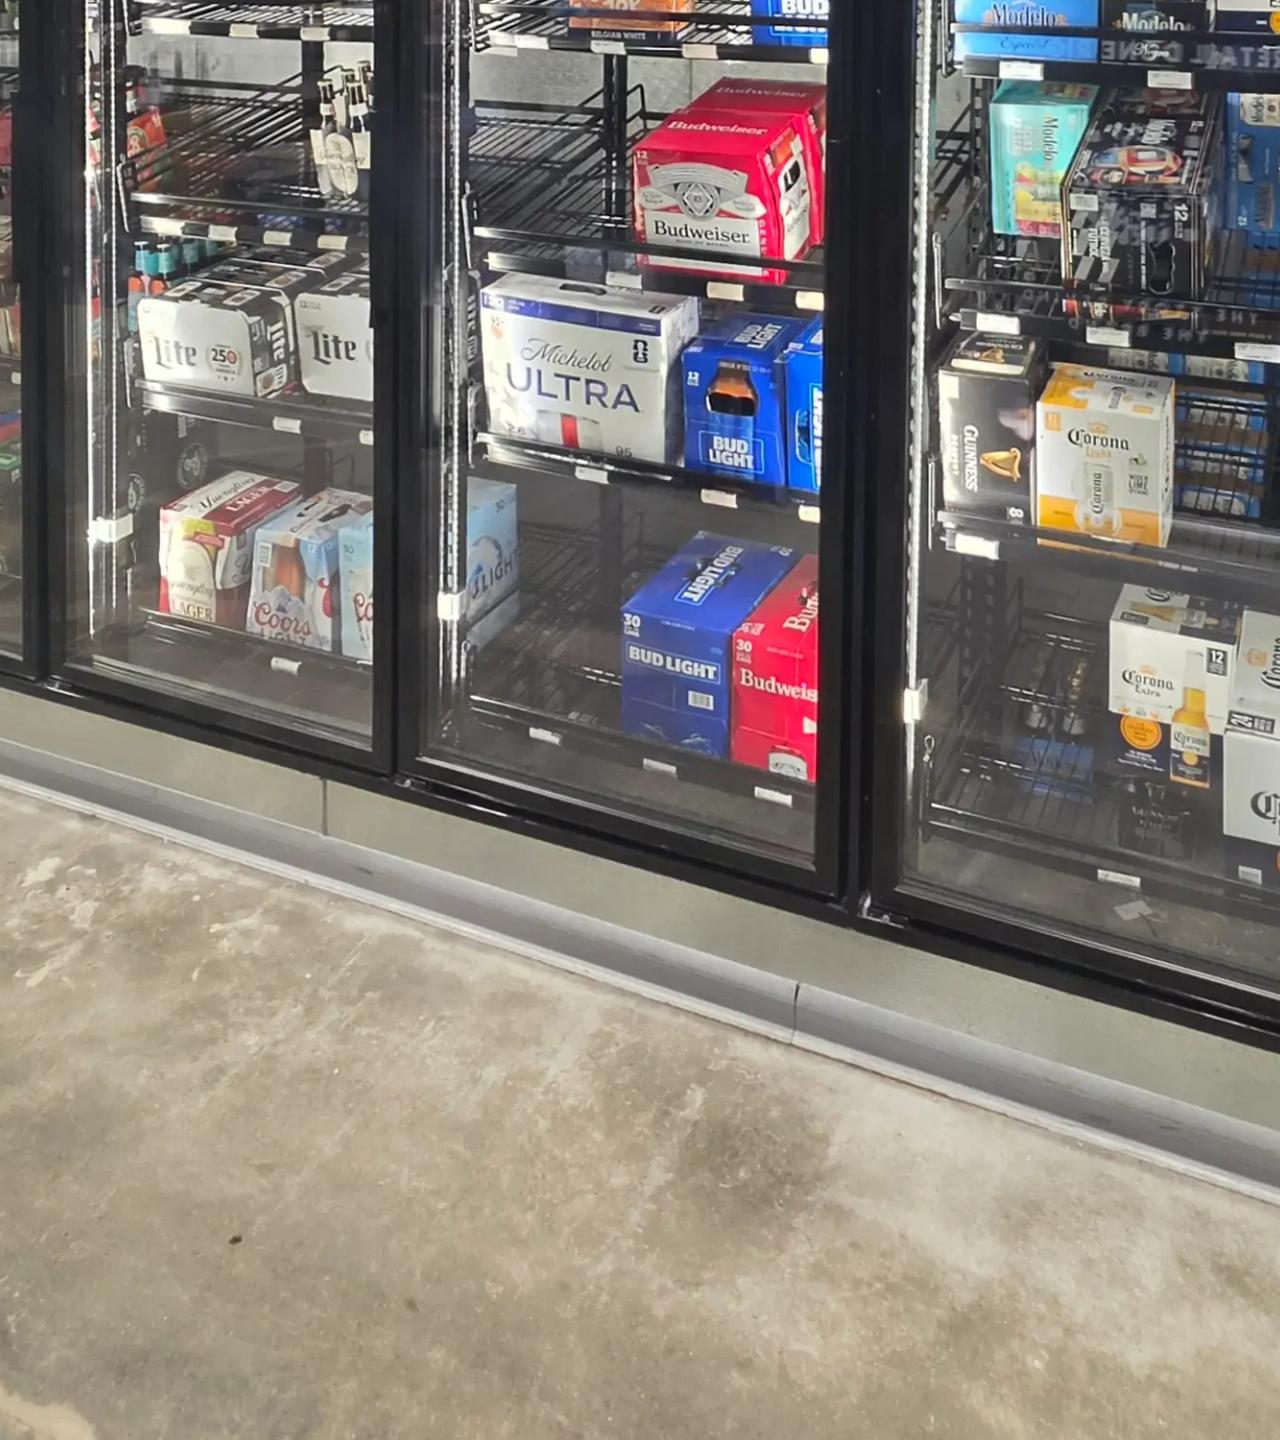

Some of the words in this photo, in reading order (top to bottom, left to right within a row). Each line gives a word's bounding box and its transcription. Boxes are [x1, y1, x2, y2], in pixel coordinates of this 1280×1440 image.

[991, 3, 1057, 27] Modelo
[623, 32, 646, 40] WHITE
[667, 120, 768, 136] Budweiser
[1042, 114, 1059, 162] Modelo
[635, 150, 648, 159] 12
[1173, 202, 1189, 222] 12
[653, 219, 750, 244] Budweiser
[153, 335, 197, 369] Lite
[268, 320, 286, 361] Lite
[311, 330, 357, 365] Lite
[521, 338, 612, 373] Michelob
[507, 362, 640, 413] ULTRA
[712, 435, 749, 453] BUD
[1067, 426, 1130, 451] Corona
[709, 449, 754, 469] LIGHT
[963, 424, 980, 493] GUINNESS
[226, 485, 269, 512] LAGER
[1091, 472, 1103, 515] Corona
[1010, 507, 1024, 518] 8
[715, 545, 744, 571] BUD
[171, 581, 215, 597] uengling
[683, 564, 723, 602] LIGHT
[254, 601, 312, 636] Coors
[623, 613, 641, 628] 30
[736, 639, 752, 652] 30
[1211, 650, 1224, 664] 12
[628, 645, 664, 668] BUD
[666, 656, 718, 680] LIGHT
[740, 667, 818, 703] Budweis
[1122, 668, 1174, 691] Corona
[1135, 684, 1161, 697] Extra
[1231, 712, 1252, 728] 24
